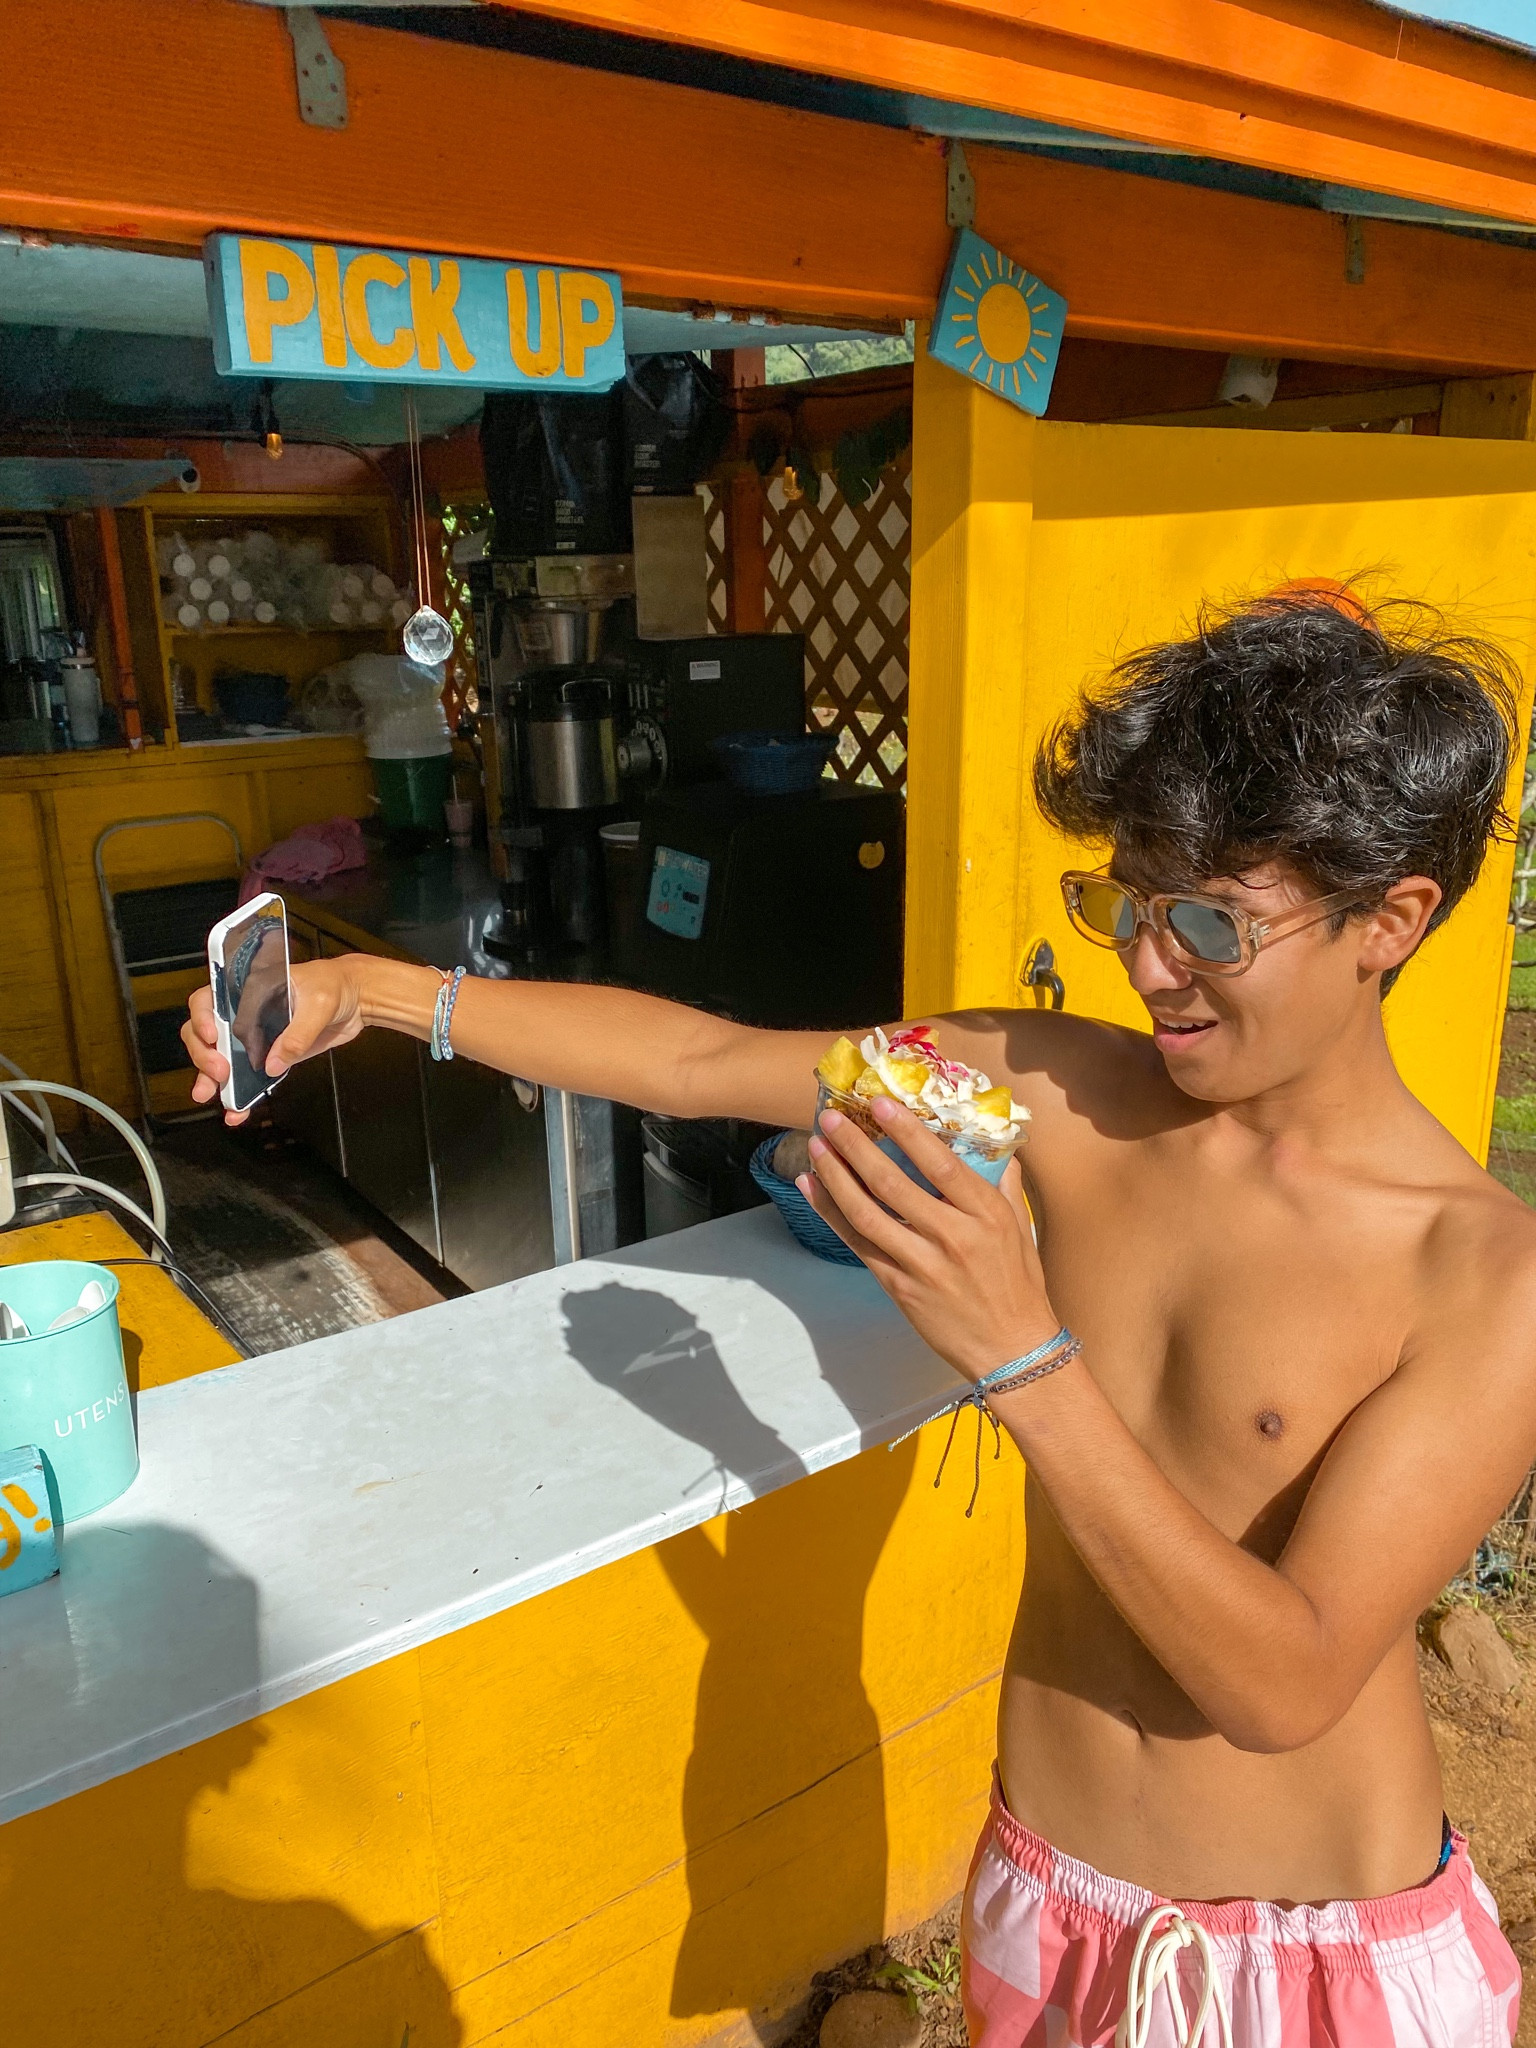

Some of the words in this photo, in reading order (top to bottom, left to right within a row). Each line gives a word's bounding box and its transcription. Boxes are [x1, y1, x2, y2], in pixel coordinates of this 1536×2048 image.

[238, 238, 477, 373] PICK
[505, 268, 616, 379] UP
[54, 1381, 125, 1438] UTENS
